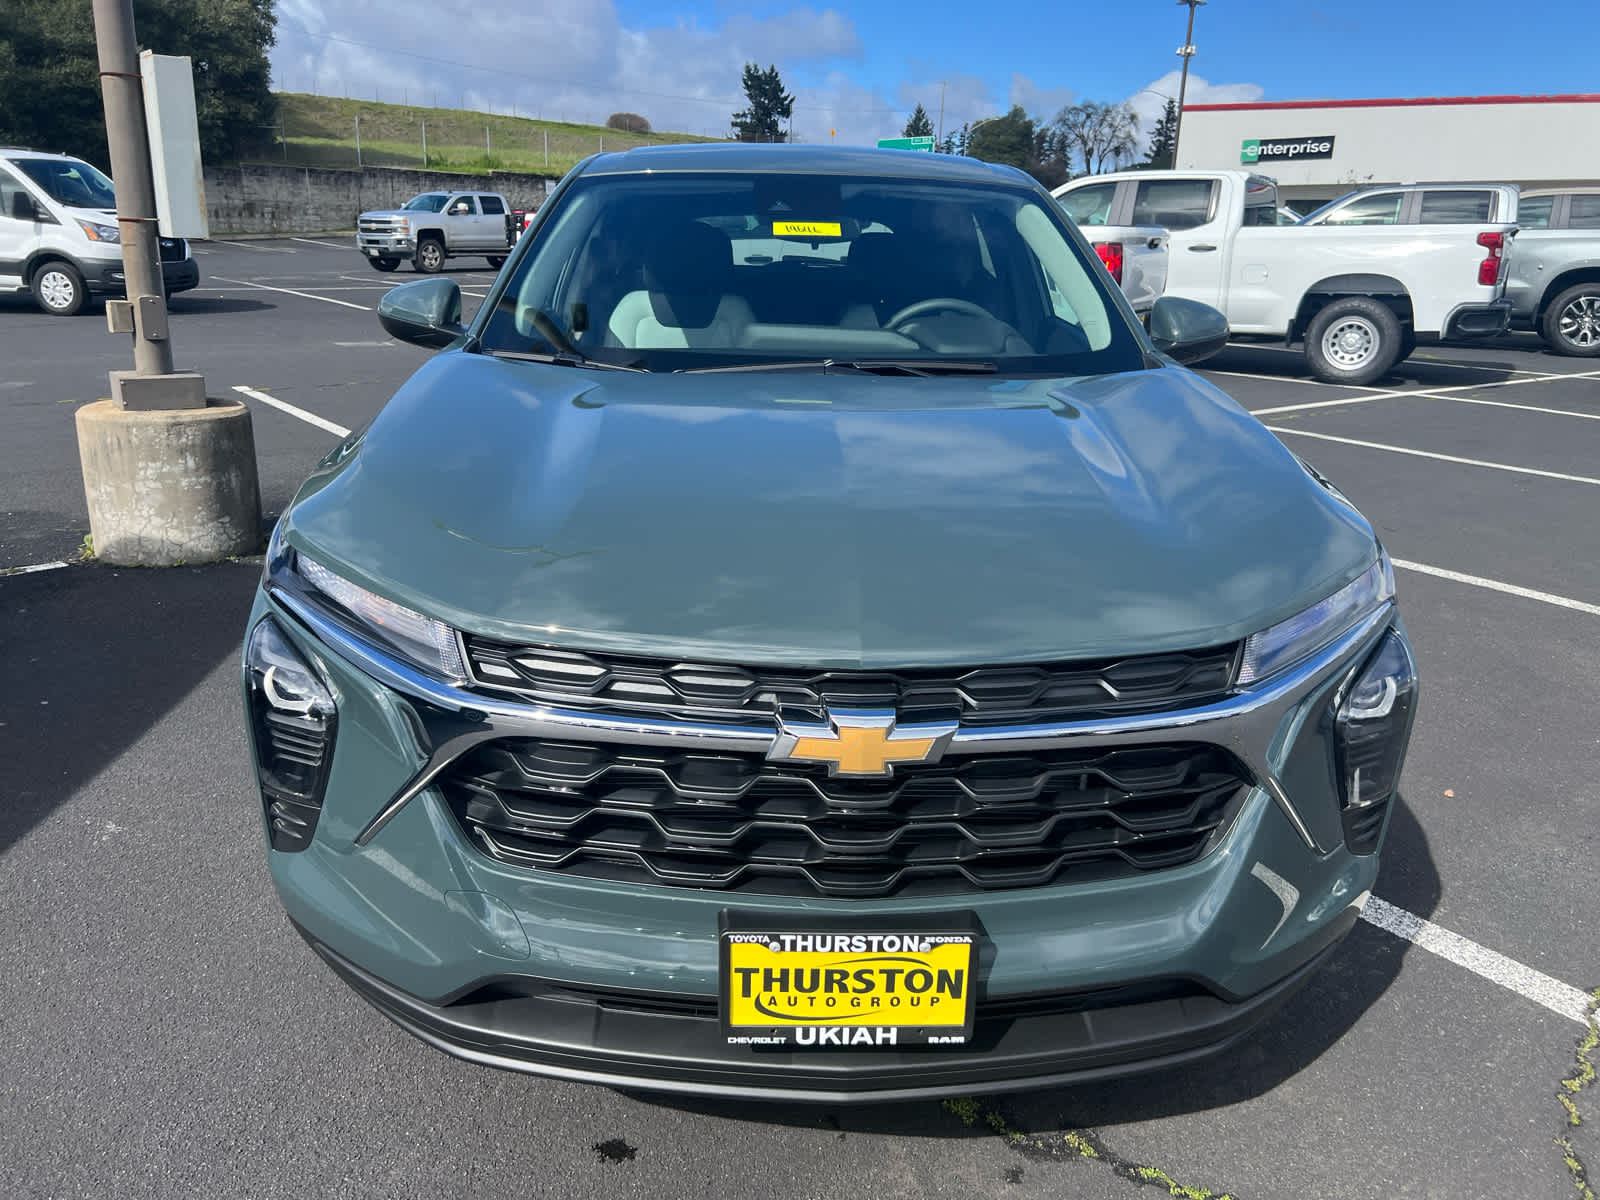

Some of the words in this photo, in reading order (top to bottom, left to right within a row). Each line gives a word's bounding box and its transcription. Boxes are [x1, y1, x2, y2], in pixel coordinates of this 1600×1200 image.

[1244, 140, 1331, 157] enterprise
[728, 935, 770, 943] TOYOTA
[779, 935, 920, 953] THURSTON
[734, 967, 964, 1000] THURSTON
[767, 996, 837, 1007] AUTO
[850, 996, 941, 1007] GROUP
[728, 1036, 787, 1044] CHEVROLET
[795, 1027, 897, 1045] UKIAH
